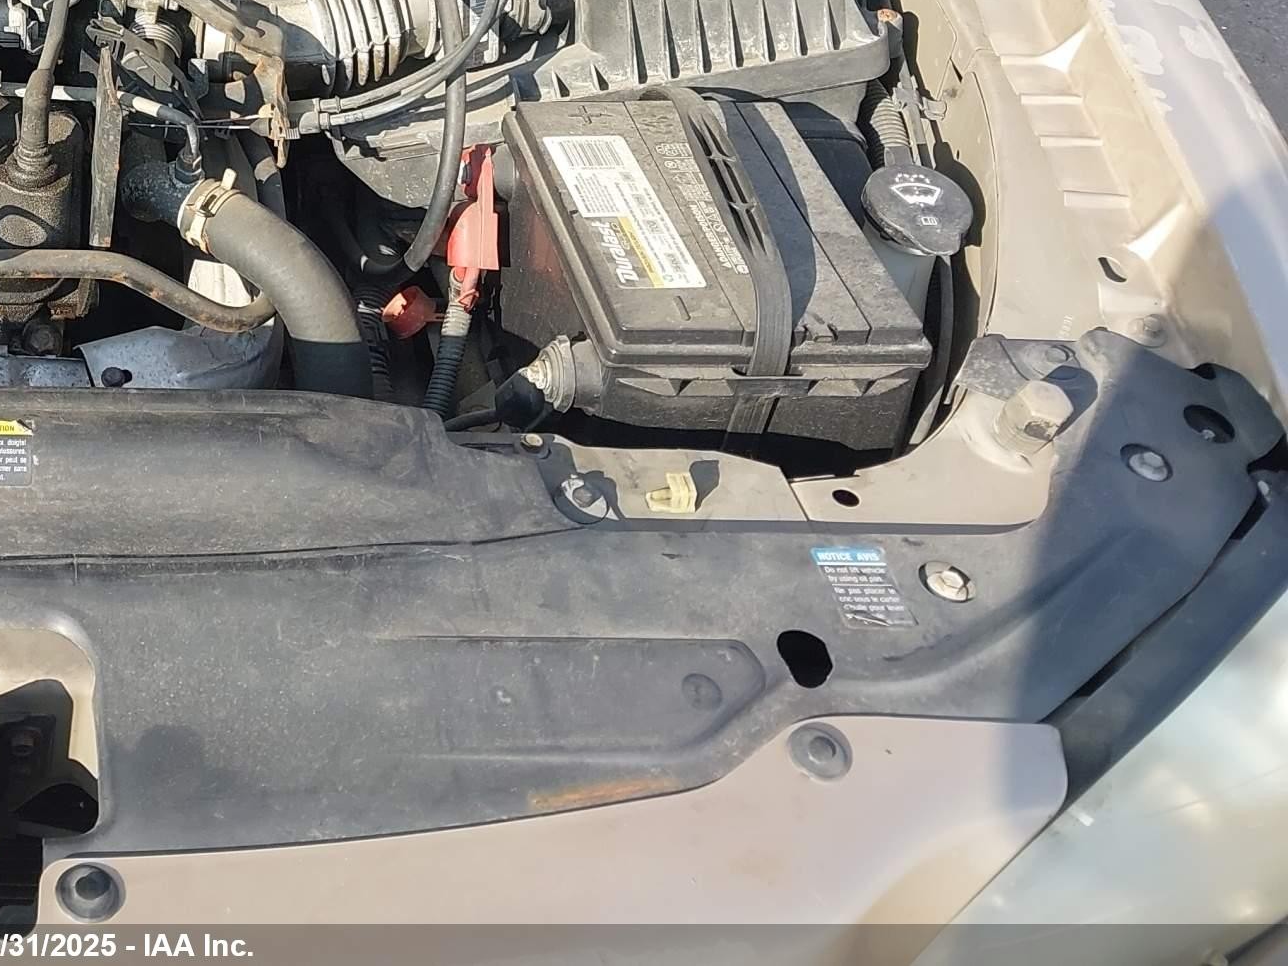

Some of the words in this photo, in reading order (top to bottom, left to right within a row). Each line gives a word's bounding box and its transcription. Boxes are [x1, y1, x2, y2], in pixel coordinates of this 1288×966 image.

[592, 221, 639, 283] Duralast
[7, 439, 27, 447] doigts!
[5, 456, 17, 464] peut
[817, 553, 853, 561] NOTICE
[856, 553, 880, 561] AVIS
[828, 575, 837, 583] by
